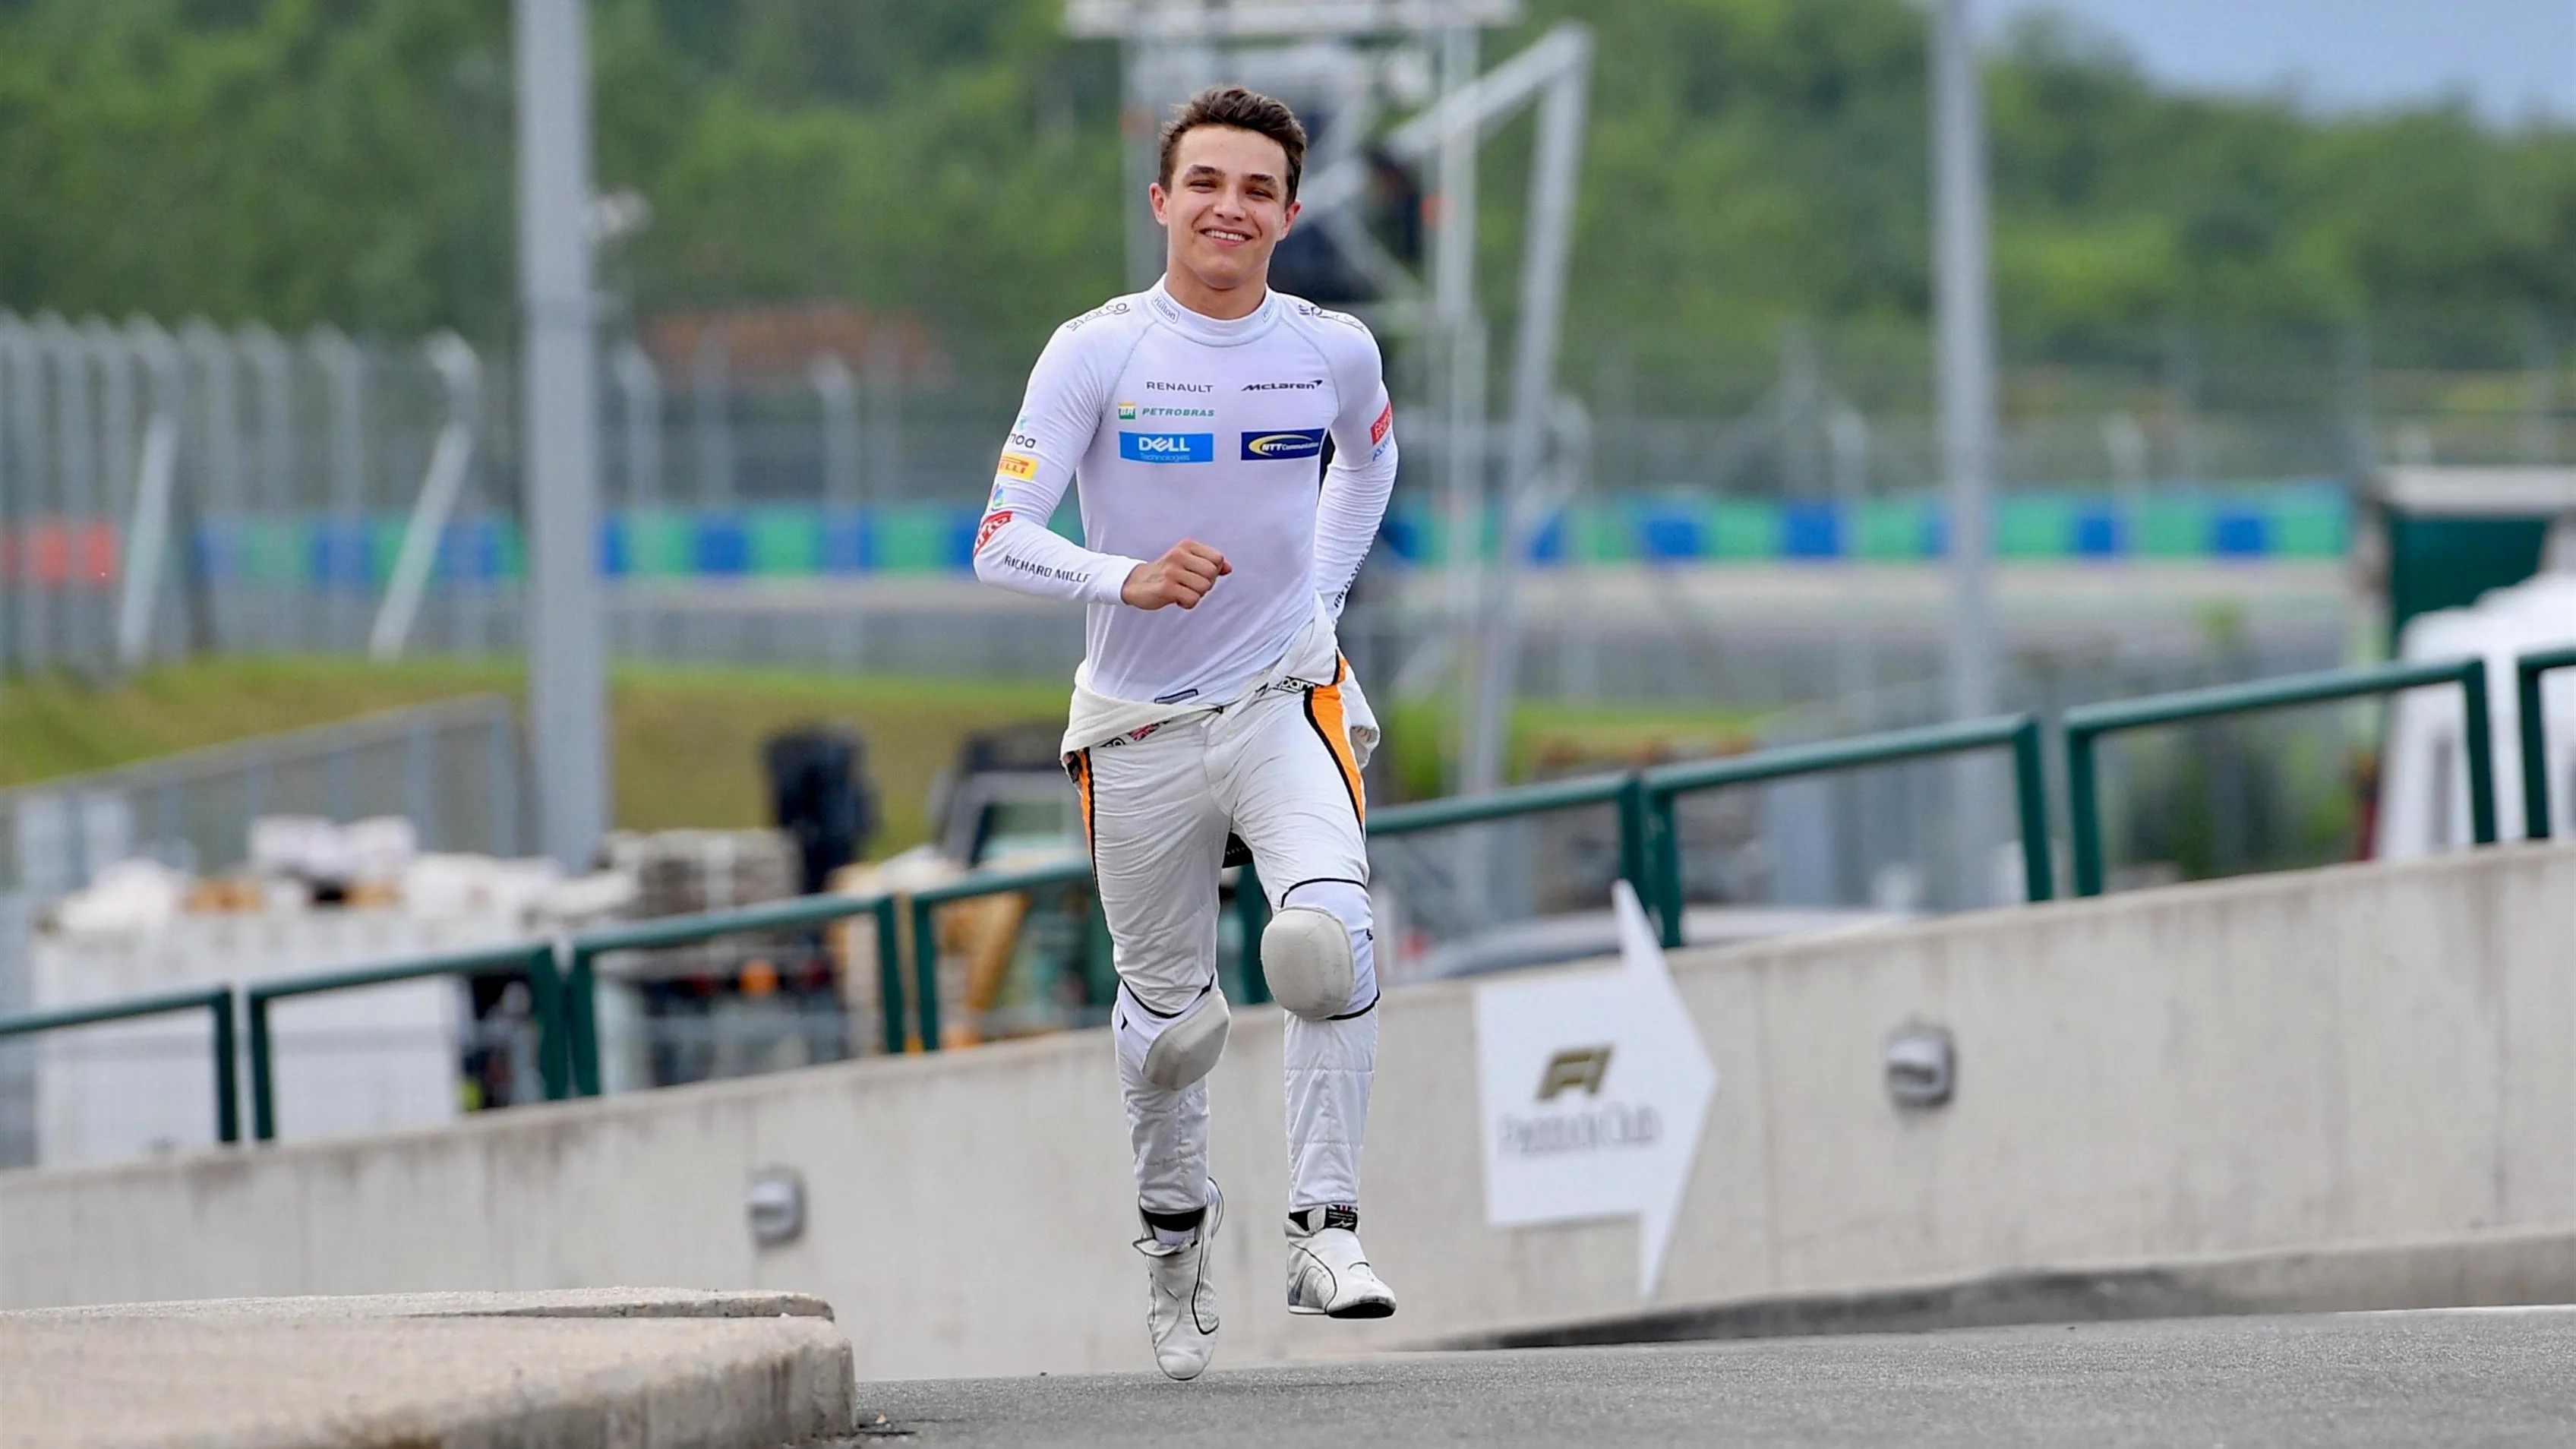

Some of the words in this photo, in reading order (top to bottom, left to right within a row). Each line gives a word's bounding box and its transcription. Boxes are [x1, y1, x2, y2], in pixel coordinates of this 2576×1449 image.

[1154, 296, 1177, 320] Hilton
[1146, 381, 1214, 393] RENAULT
[1242, 380, 1323, 391] McLaren
[1141, 408, 1214, 417] PETROBRAS
[1138, 437, 1190, 452] DELL
[1004, 555, 1053, 577] RICHARD
